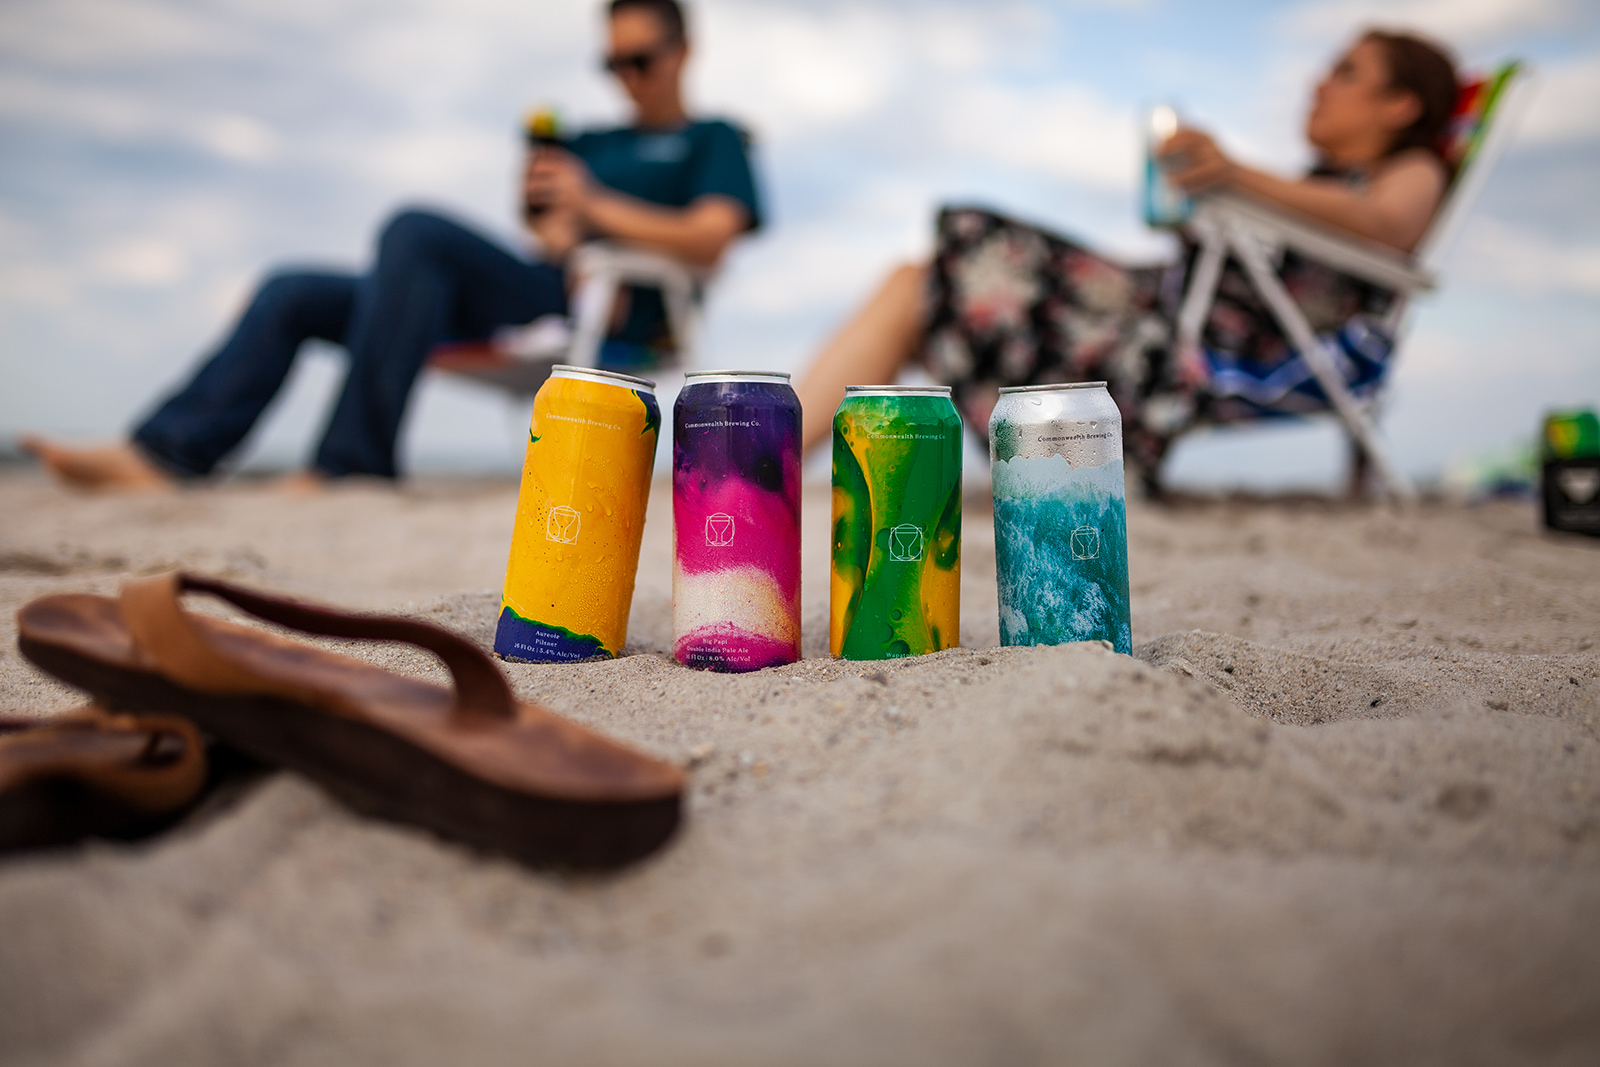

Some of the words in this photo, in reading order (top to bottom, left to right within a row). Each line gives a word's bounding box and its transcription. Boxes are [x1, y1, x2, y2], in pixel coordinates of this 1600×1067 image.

[546, 412, 587, 424] Commonwealth
[587, 419, 612, 430] Brewing
[684, 420, 724, 429] Commonwealth
[535, 630, 560, 640] Aureole
[535, 638, 558, 648] Pilsner
[713, 638, 728, 646] Papi
[556, 651, 580, 659] Alc/Vol
